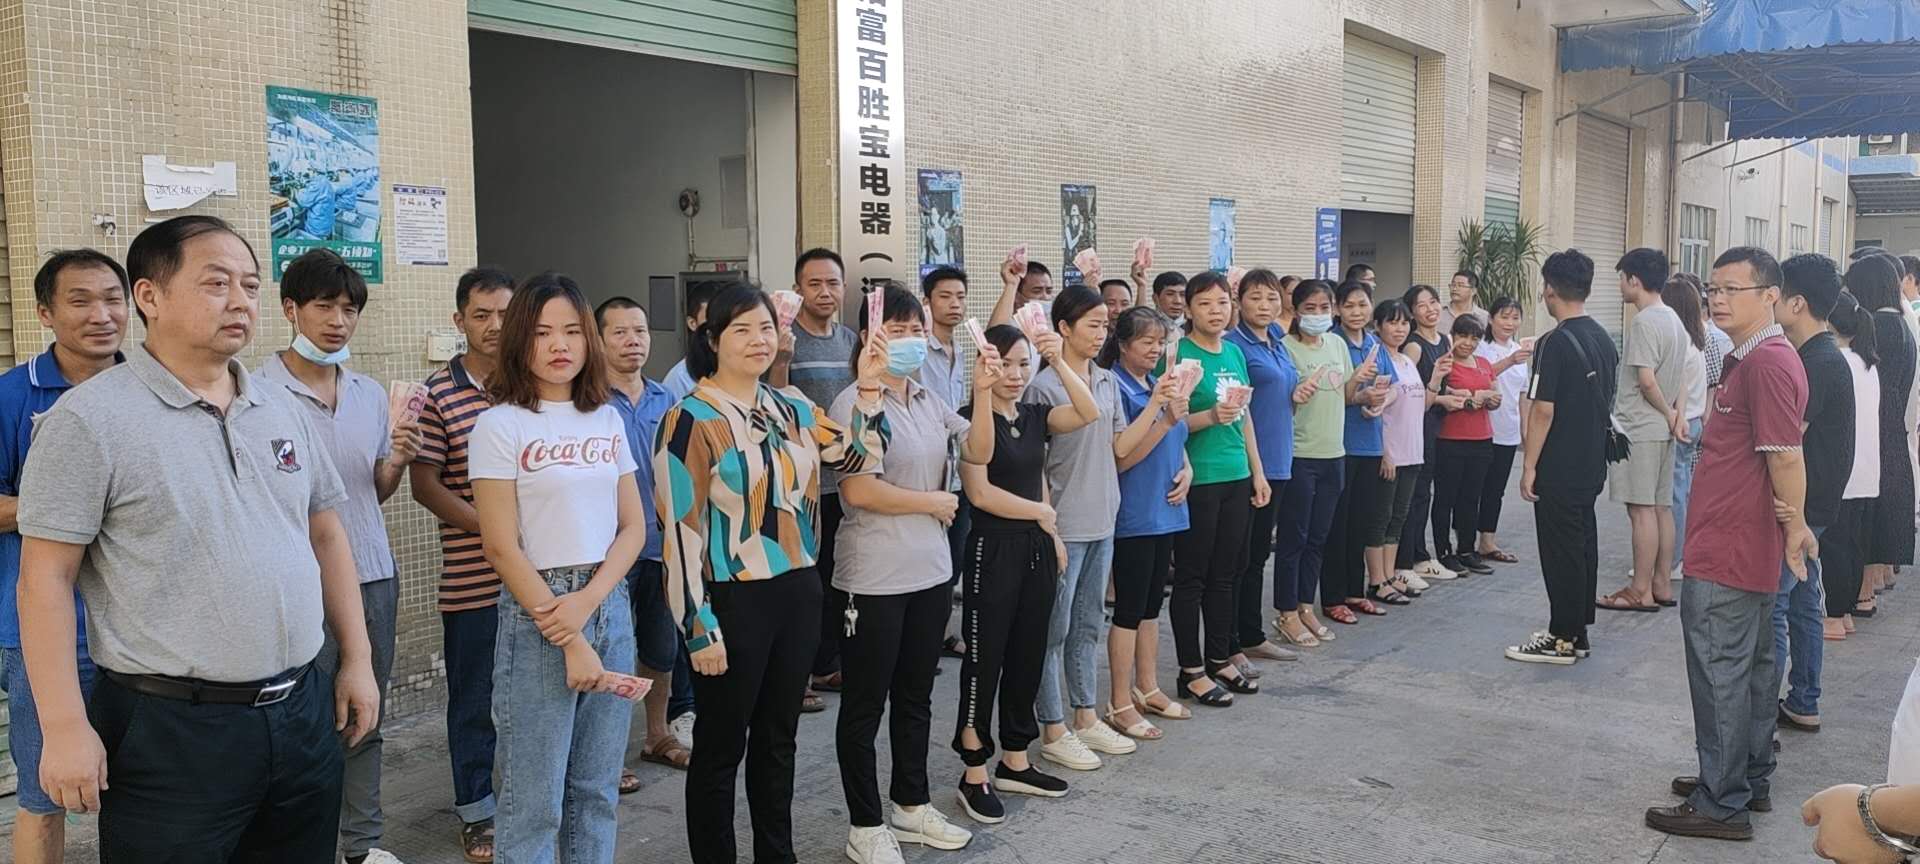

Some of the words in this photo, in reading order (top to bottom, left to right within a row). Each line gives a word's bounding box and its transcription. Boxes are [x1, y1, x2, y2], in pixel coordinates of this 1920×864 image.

[856, 0, 893, 294] 富百胜宝电器（
[521, 434, 620, 472] Coca-Col
